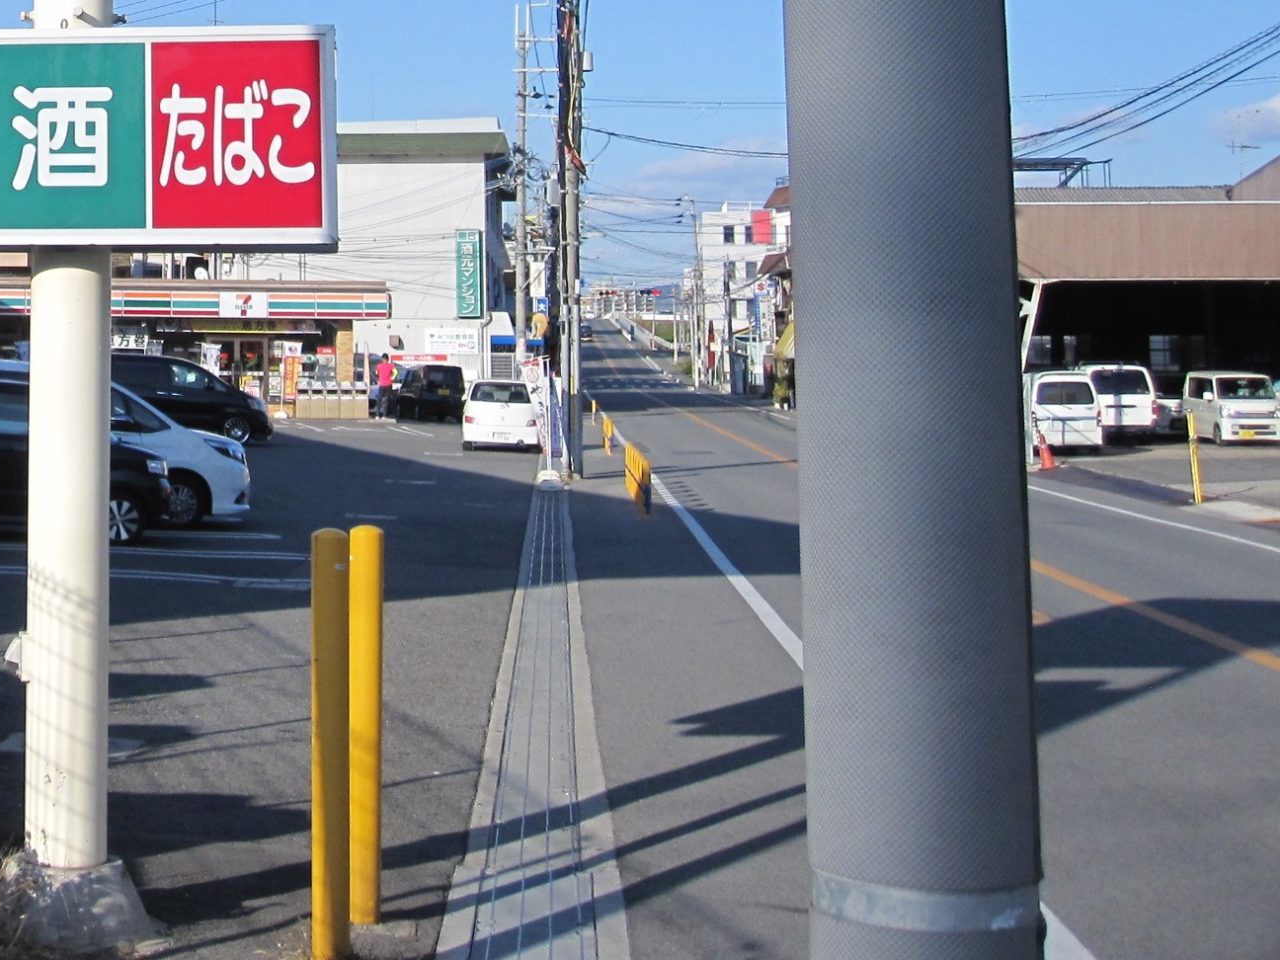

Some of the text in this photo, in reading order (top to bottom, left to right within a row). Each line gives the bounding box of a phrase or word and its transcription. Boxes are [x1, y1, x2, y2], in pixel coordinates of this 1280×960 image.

[11, 85, 114, 192] 酒
[158, 78, 316, 187] たばこ
